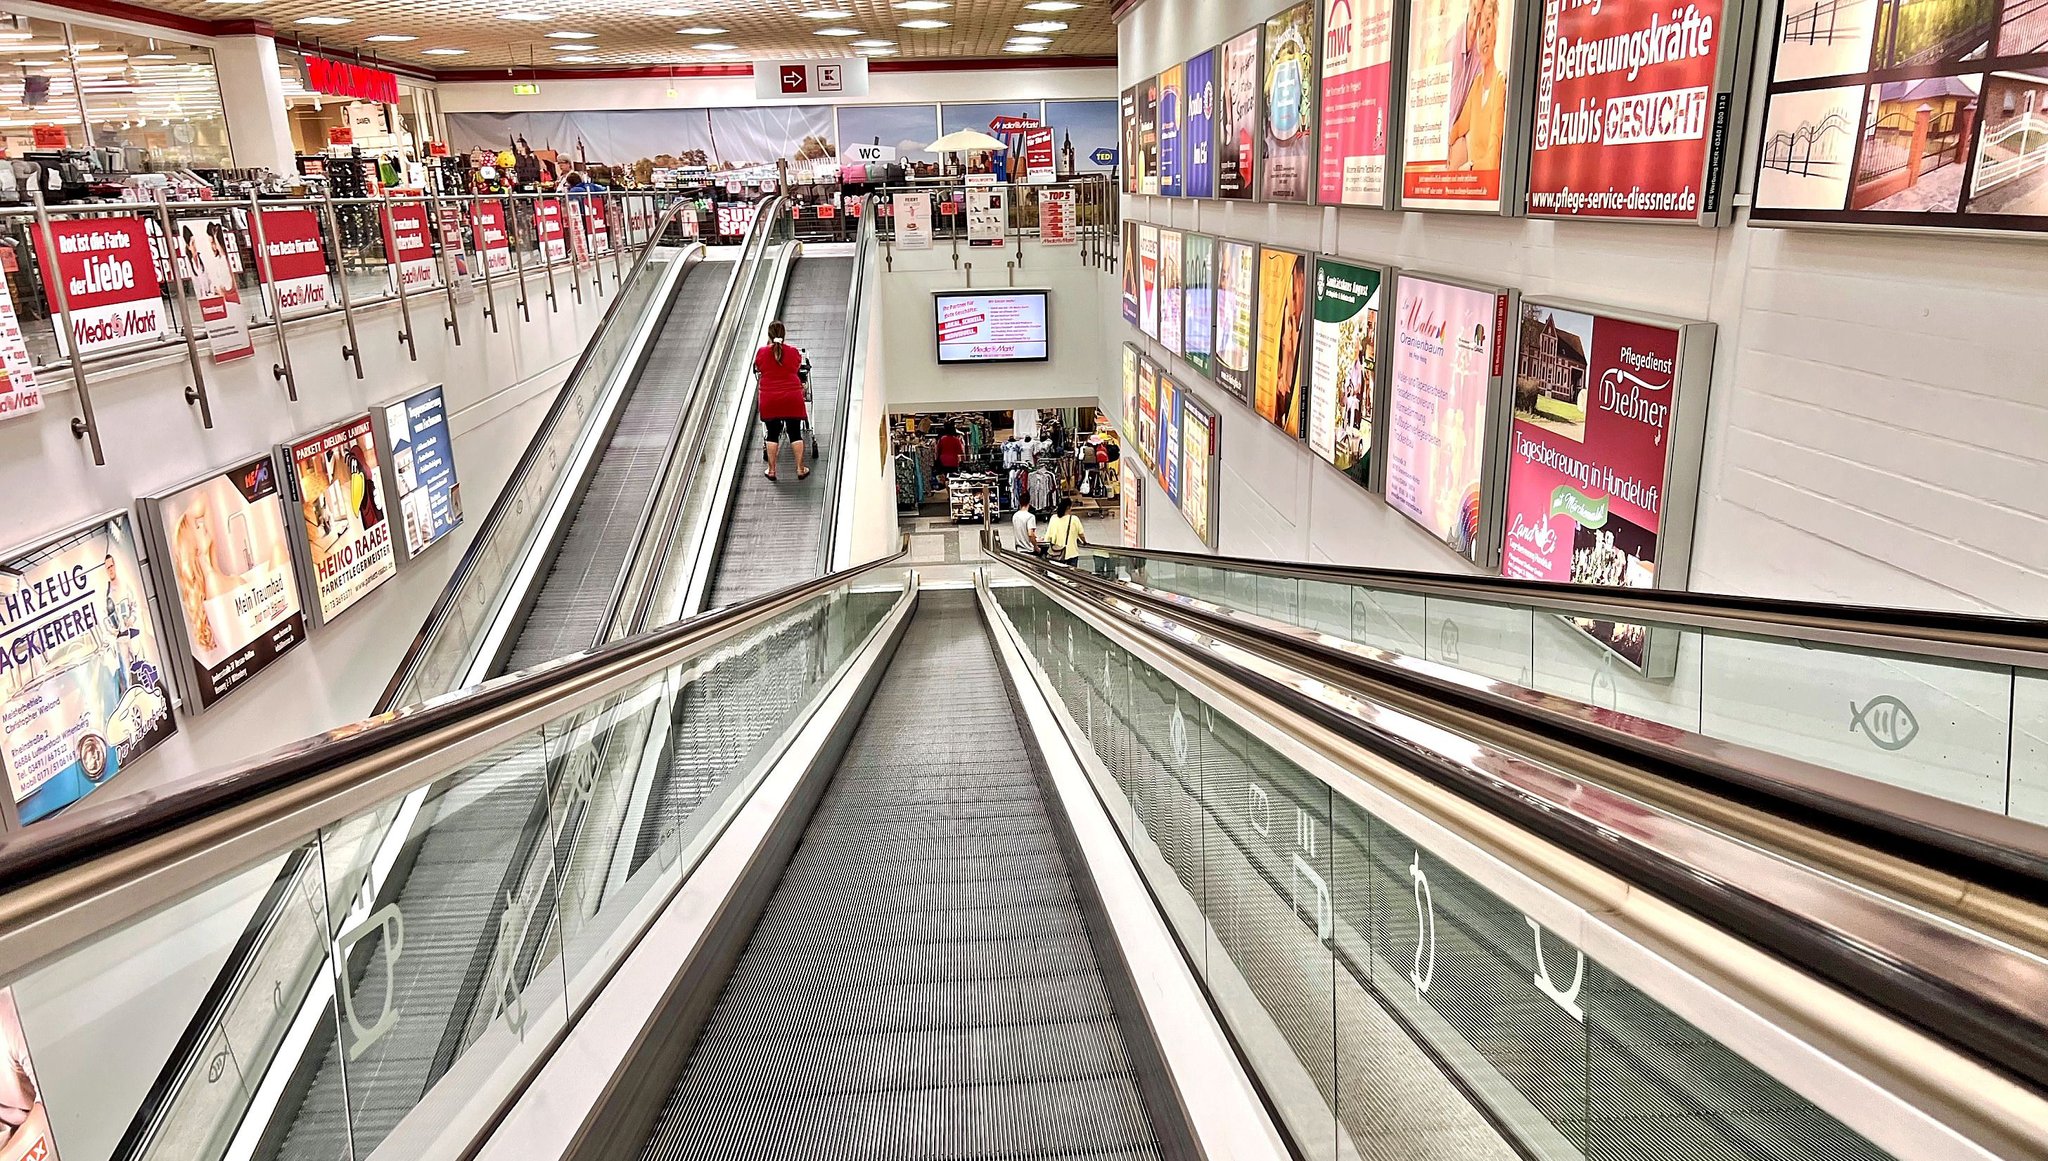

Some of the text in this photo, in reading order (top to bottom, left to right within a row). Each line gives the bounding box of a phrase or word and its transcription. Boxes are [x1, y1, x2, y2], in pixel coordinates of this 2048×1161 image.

[1556, 4, 1713, 82] Betreuungskräfte
[1550, 91, 1706, 146] Azubis GESUCHT
[859, 148, 881, 159] WC
[1049, 191, 1071, 200] TOP 5
[1532, 186, 1696, 214] www.pflege-service-diessner.de
[59, 230, 131, 254] Rot ist die Farbe
[70, 255, 135, 296] der Liebe
[73, 310, 156, 345] Media Markt
[1400, 332, 1444, 357] Oranienbaum
[1620, 346, 1672, 375] Pflegedienst
[1603, 379, 1668, 429] Dießner
[296, 421, 371, 461] PARKETT DIELUNG LAMINAT
[1515, 430, 1659, 514] Tagesbetreuung in Hundeluft
[317, 523, 389, 583] HEIKO RAABE
[235, 577, 285, 617] Mein Traumbad
[0, 602, 98, 675] ACKIEREREI
[2, 696, 43, 724] Meisterbetrieb
[5, 696, 61, 735] Christopher Wieland
[11, 733, 43, 757] Rheinstraße
[61, 720, 89, 744] Wittenberg
[20, 777, 36, 794] Mobil
